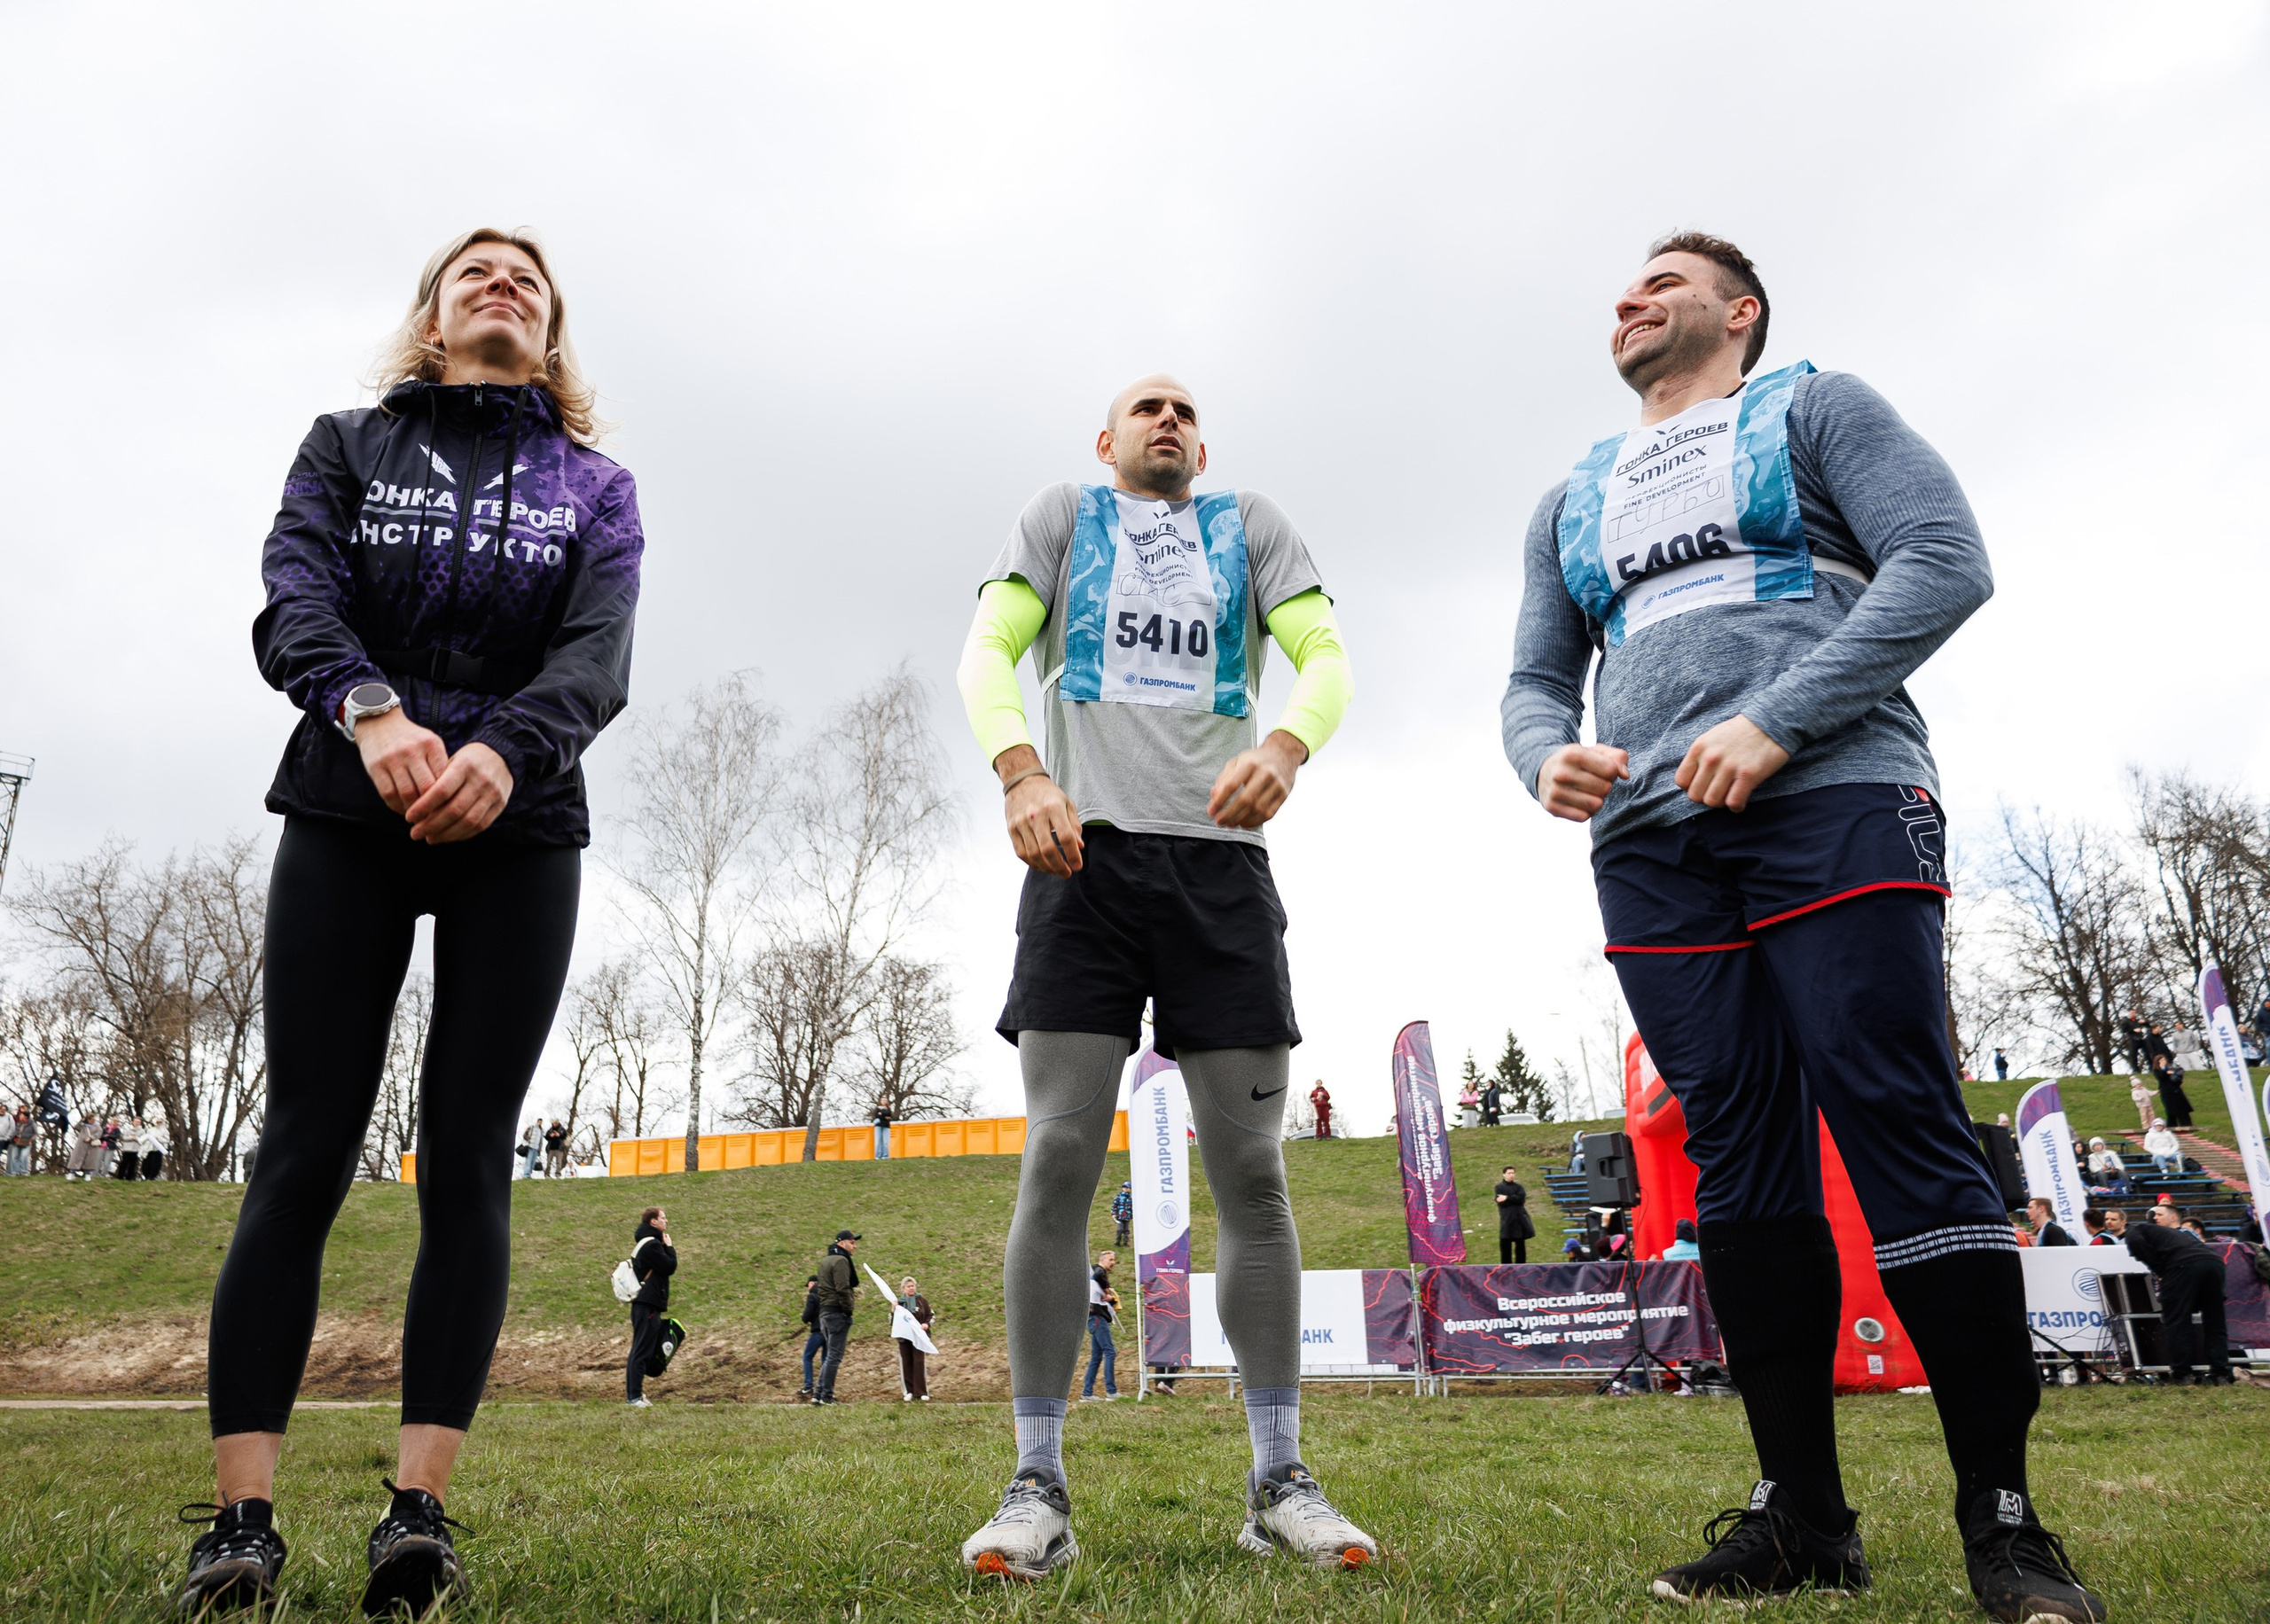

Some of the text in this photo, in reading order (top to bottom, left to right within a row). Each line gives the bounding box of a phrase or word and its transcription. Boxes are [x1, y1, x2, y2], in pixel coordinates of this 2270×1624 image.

[1616, 422, 1728, 474] ГОНКА ГЕРОЕВ
[1627, 445, 1707, 488] Sminex
[365, 480, 575, 533] ОНКА ГЕРОЕВ
[1624, 472, 1706, 510] FINE DEVELOPMENT
[350, 519, 562, 567] НСТРУКТО
[1124, 527, 1157, 543] ОНКА
[1616, 522, 1731, 582] 5406
[1657, 574, 1725, 600] ГАЗПРОМБАНК
[1115, 611, 1209, 659] 5410
[1139, 676, 1196, 692] ГАЗПРОМБАНК
[1153, 1085, 1174, 1194] ГАЗПРОМБАНК
[2039, 1129, 2074, 1223] ГАЗПРОМБАНК
[1444, 1304, 1689, 1334] физкультурное мероприятие
[1497, 1292, 1626, 1311] Всероссийское
[2027, 1310, 2110, 1328] ГАЗПРО
[1504, 1325, 1630, 1347] "Забег героев"
